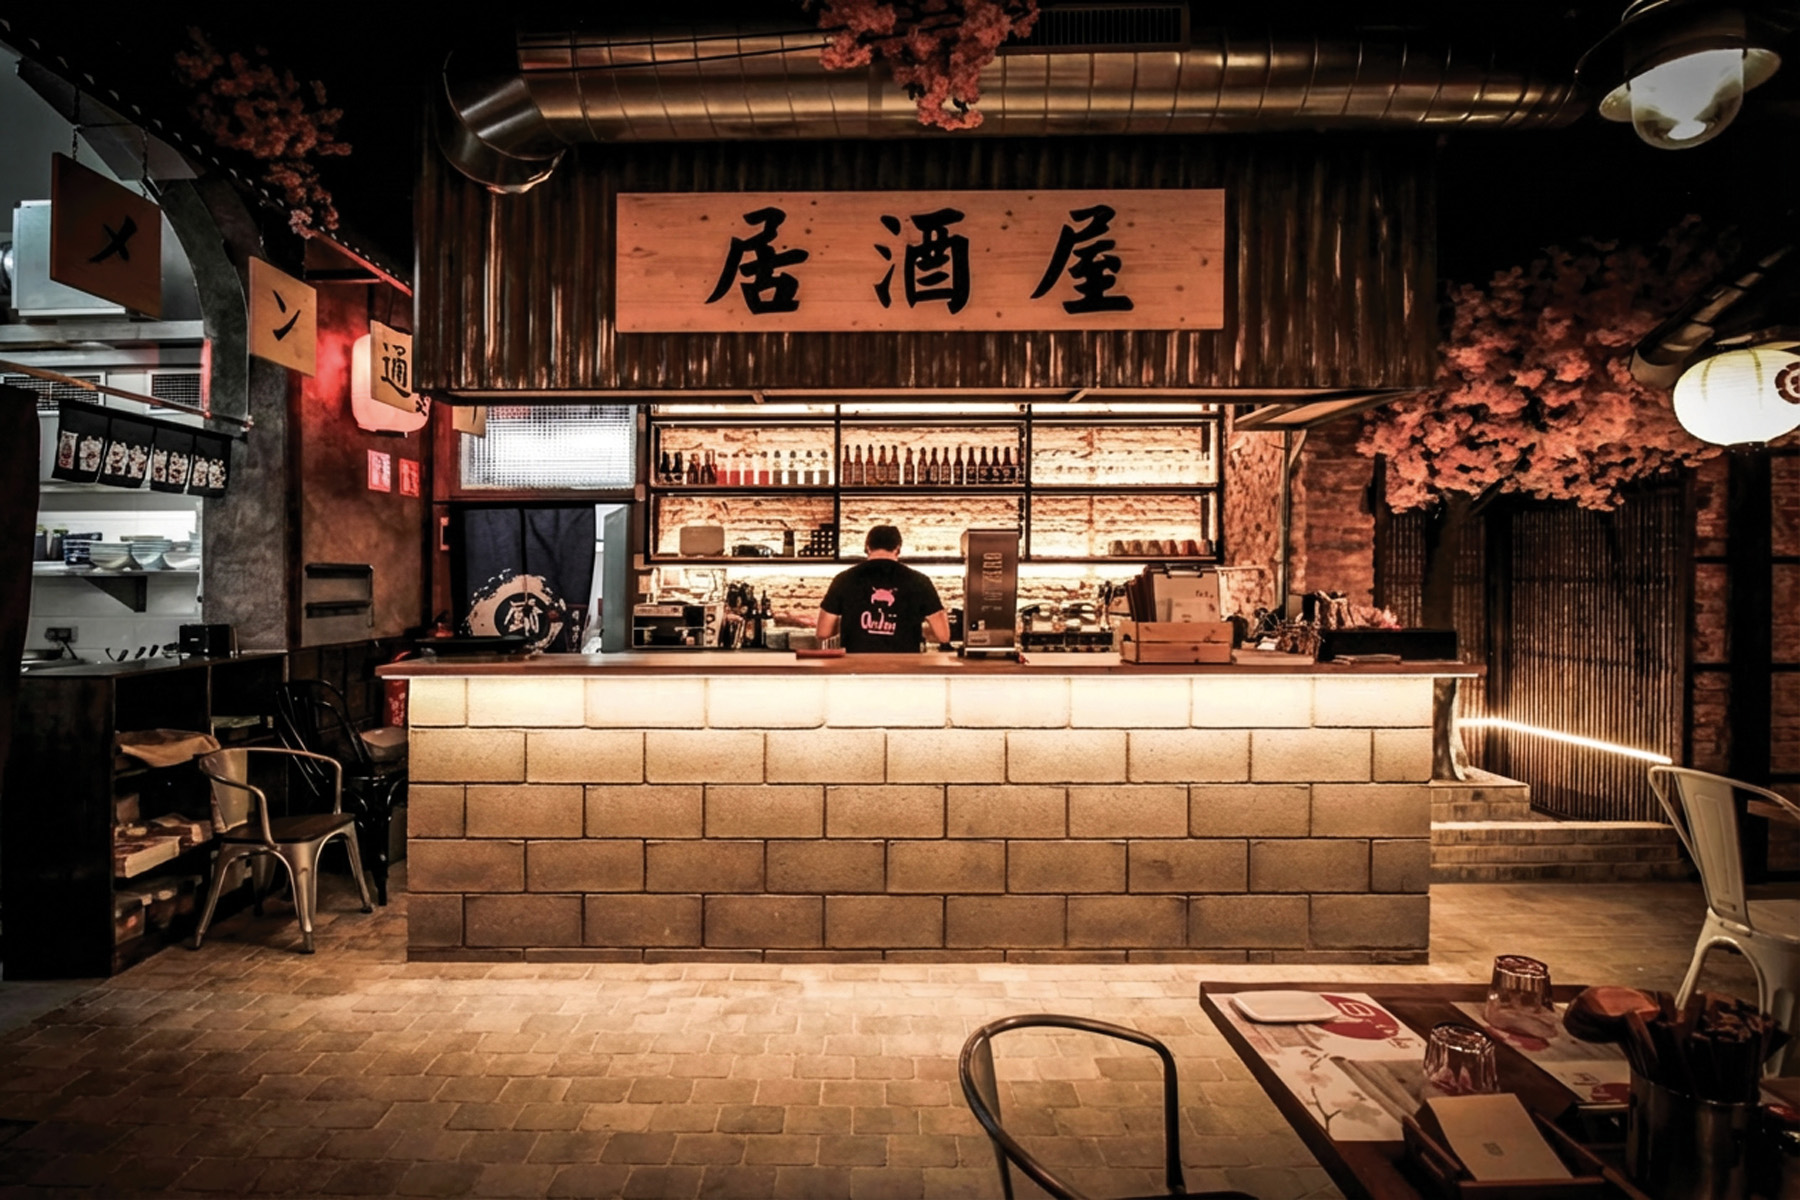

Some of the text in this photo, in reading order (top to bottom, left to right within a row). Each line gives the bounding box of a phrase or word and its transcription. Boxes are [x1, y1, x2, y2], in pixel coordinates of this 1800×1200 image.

[89, 215, 137, 263] メ
[704, 204, 1134, 315] 居酒屋
[380, 342, 411, 398] 通
